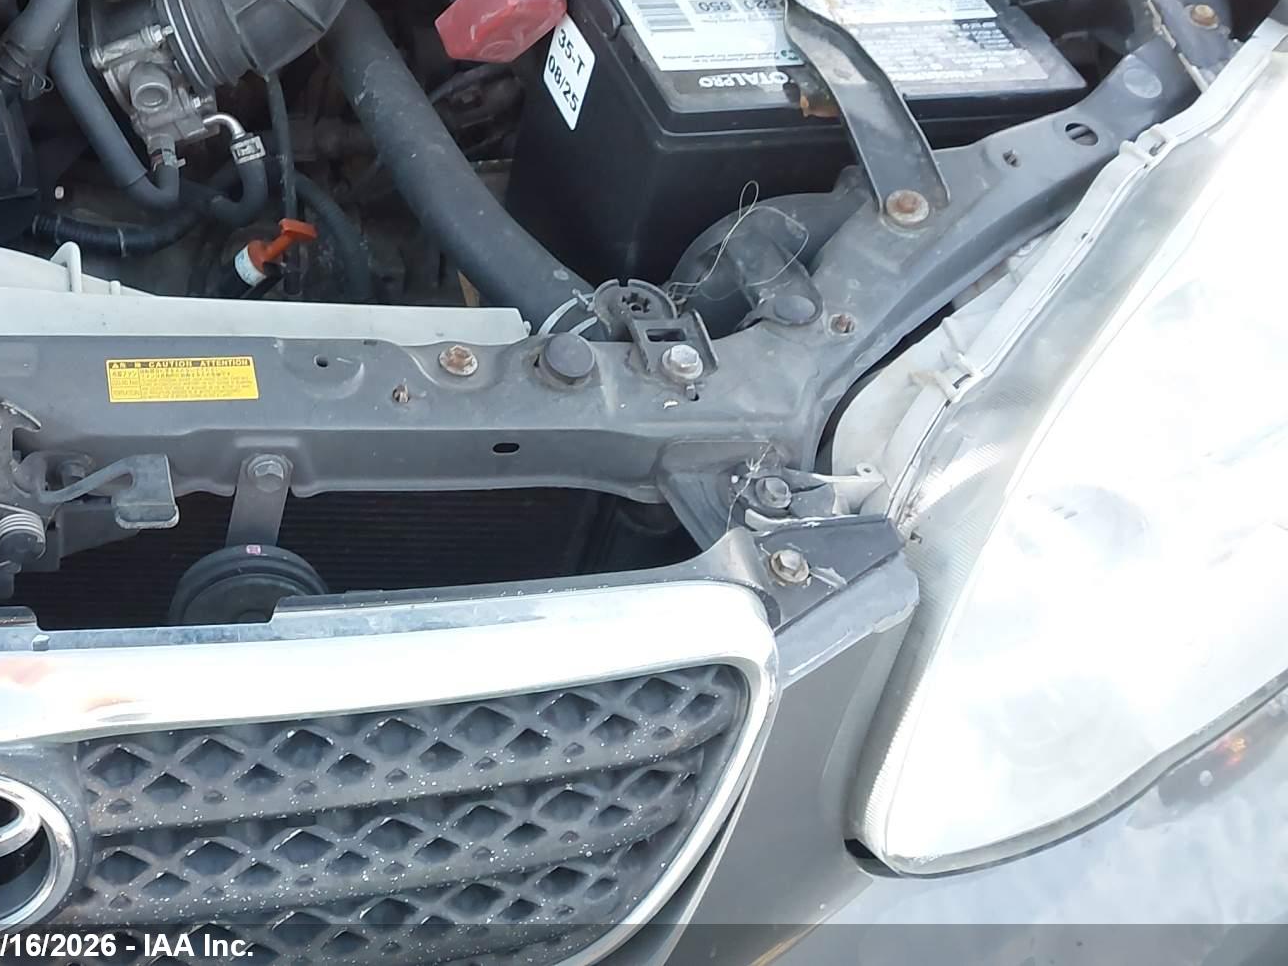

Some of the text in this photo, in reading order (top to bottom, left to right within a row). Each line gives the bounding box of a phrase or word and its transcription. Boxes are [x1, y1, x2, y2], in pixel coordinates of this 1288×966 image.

[557, 29, 586, 77] 35-T
[547, 54, 580, 112] 08/25
[149, 360, 193, 369] CAUTION
[199, 359, 248, 368] ATTENTION
